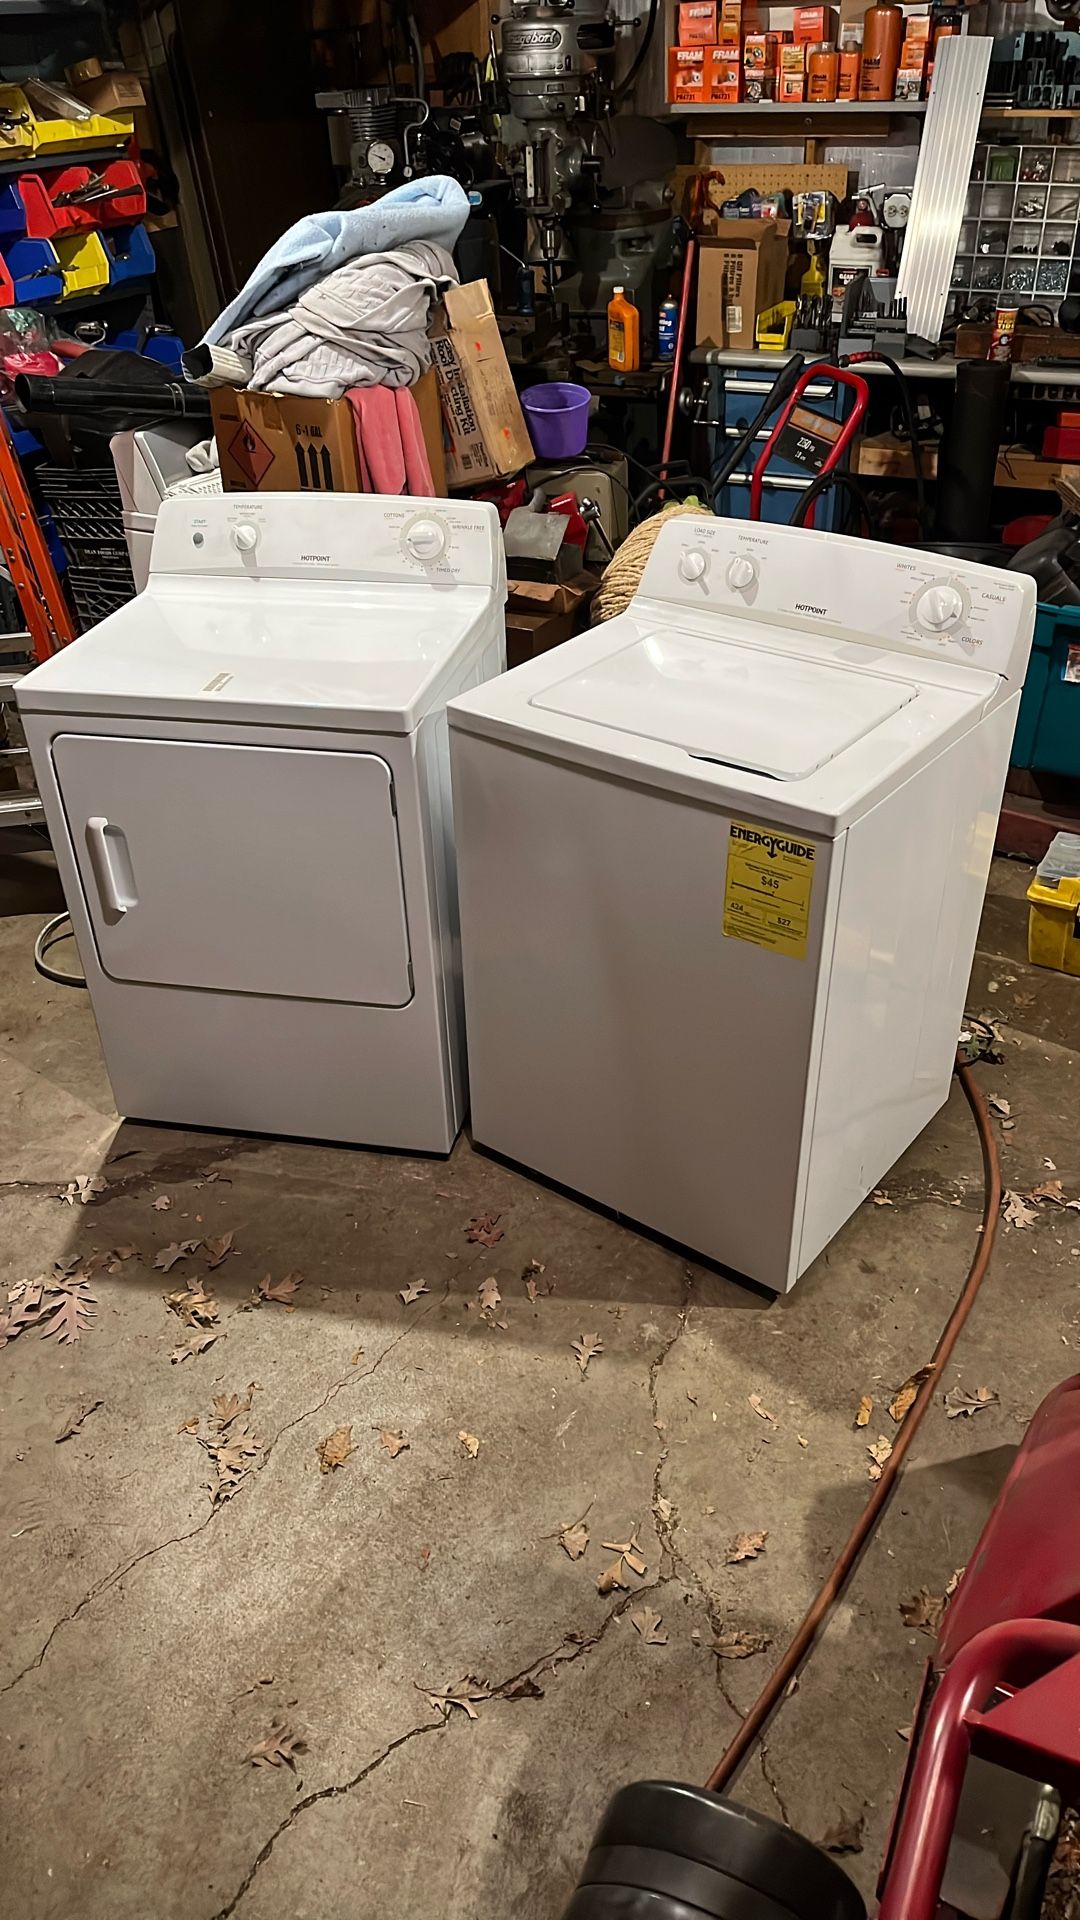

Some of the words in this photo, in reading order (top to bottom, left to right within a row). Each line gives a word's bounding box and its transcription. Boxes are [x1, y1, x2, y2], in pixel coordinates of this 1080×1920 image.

[677, 51, 703, 61] FRAM
[713, 50, 739, 60] FRAM
[435, 340, 452, 367] Roof
[445, 370, 464, 416] Dcting
[460, 417, 471, 436] Kit
[310, 425, 323, 437] GAL
[694, 527, 706, 535] LOAD
[738, 535, 769, 545] TEMPERATURE
[300, 554, 331, 562] HOTPOINT
[896, 562, 917, 571] WHITES
[981, 592, 1007, 602] CASUALS
[795, 603, 828, 616] HOTPOINT
[961, 636, 983, 646] COLORS
[729, 825, 816, 861] ENERGYGUIDE
[760, 875, 780, 890] $45
[776, 916, 792, 927] $27
